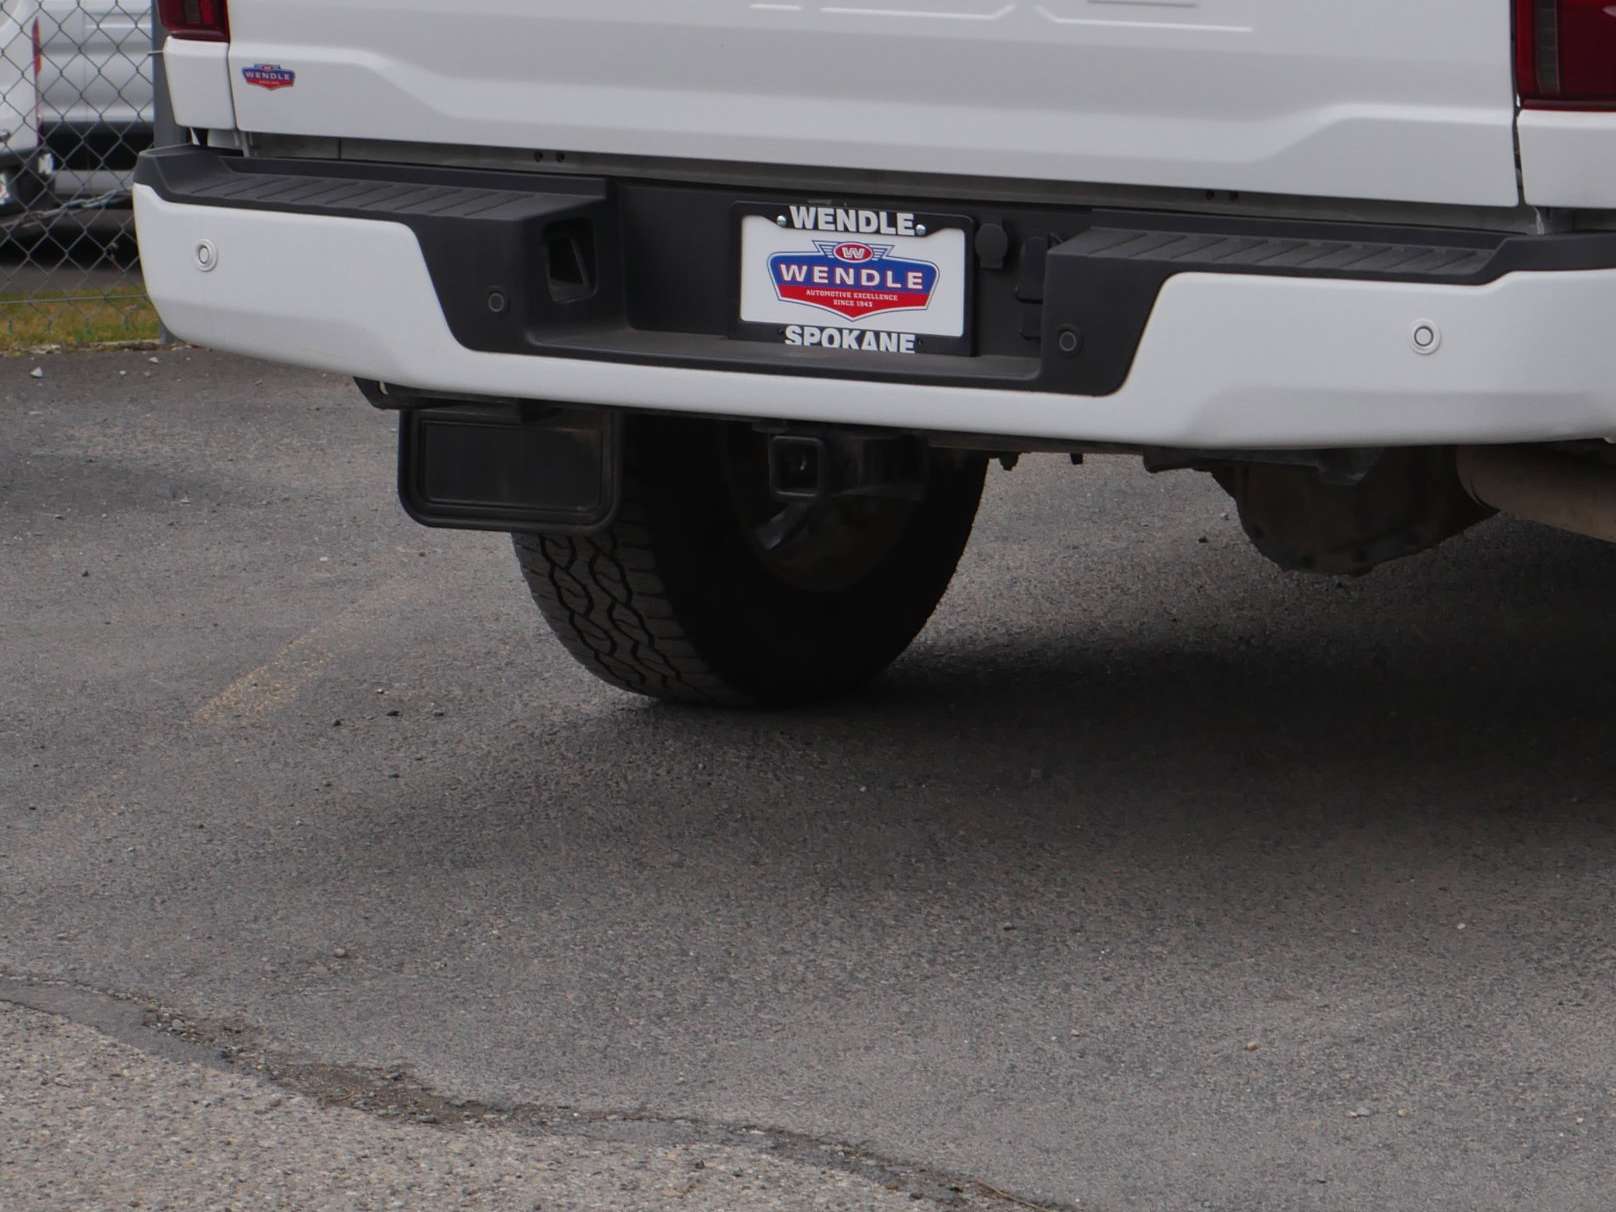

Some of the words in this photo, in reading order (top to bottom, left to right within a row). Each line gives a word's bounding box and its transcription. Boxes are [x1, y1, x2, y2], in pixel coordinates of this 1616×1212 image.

[244, 71, 290, 80] WENDLE
[789, 205, 915, 237] WENDLE
[780, 263, 923, 290] WENDLE
[806, 289, 852, 299] AUTOMOTIVE
[853, 291, 898, 302] EXCELLENCE
[833, 299, 855, 307] SINCE
[784, 324, 916, 354] SPOKANE
